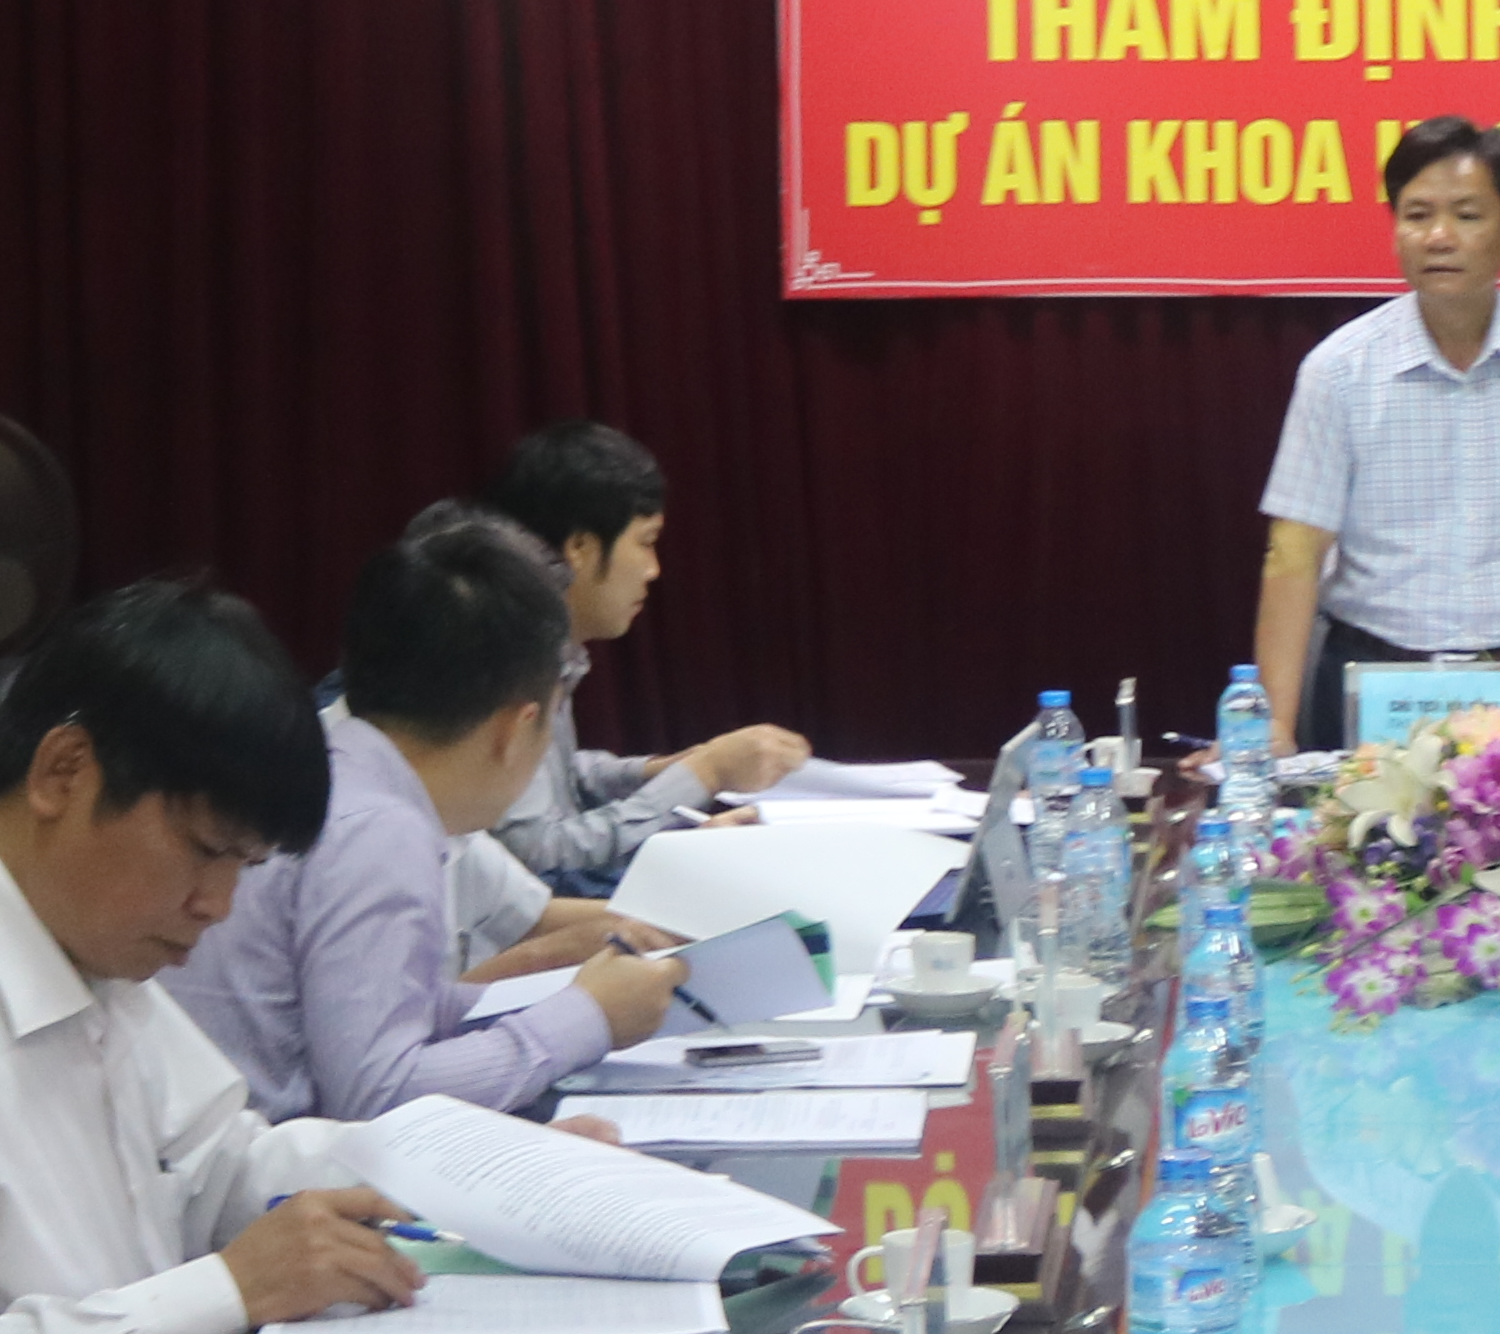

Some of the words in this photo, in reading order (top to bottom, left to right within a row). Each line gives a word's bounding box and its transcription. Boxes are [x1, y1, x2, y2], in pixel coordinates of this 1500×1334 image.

[844, 112, 970, 226] DỰ
[982, 102, 1102, 205] ÁN
[1126, 118, 1354, 205] KHOA
